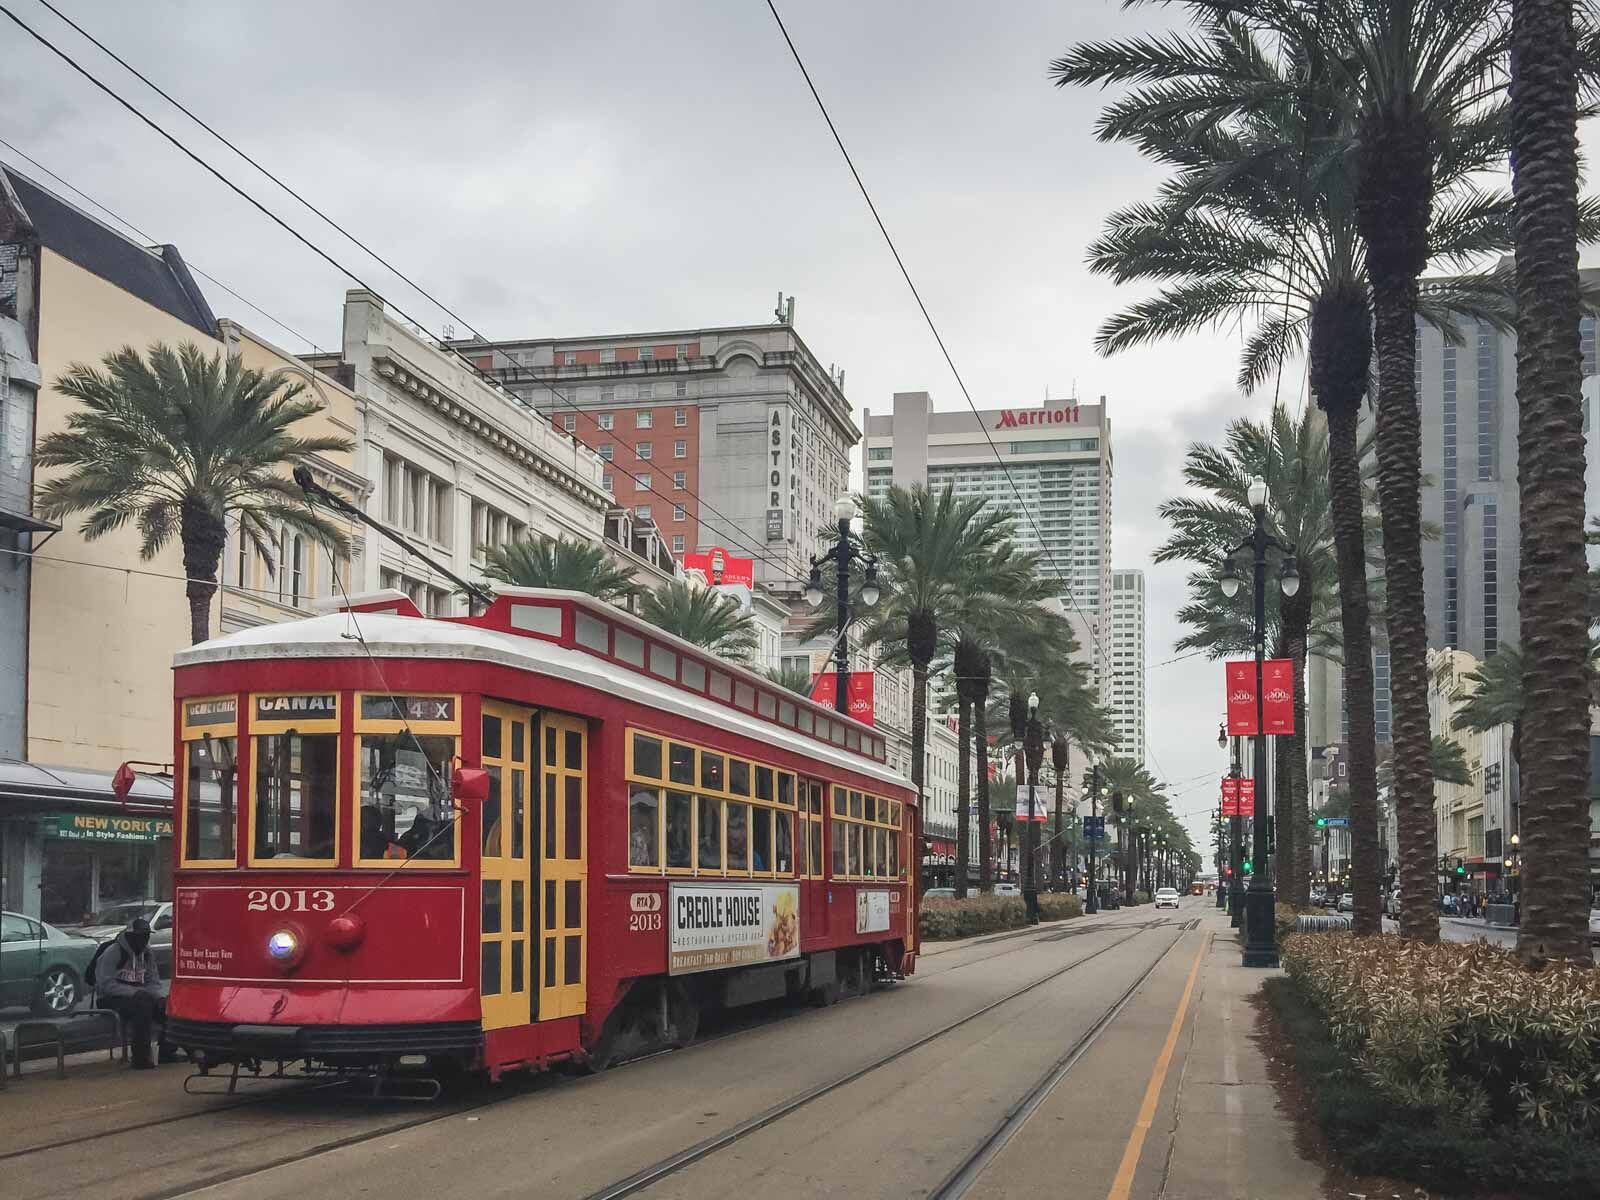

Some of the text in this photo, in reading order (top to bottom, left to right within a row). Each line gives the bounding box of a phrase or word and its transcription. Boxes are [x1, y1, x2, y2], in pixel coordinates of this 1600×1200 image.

[995, 406, 1079, 429] Marriott
[771, 410, 781, 507] ASTOR
[259, 697, 336, 711] CANAL
[75, 815, 173, 833] NEW YORK FA
[96, 832, 115, 840] Style
[247, 890, 335, 911] 2013
[636, 896, 649, 908] RTA
[677, 896, 760, 929] CREOLE HOUSE
[630, 913, 661, 930] 2013
[678, 935, 718, 946] RESTAURANT
[672, 954, 702, 969] BREAKFAST
